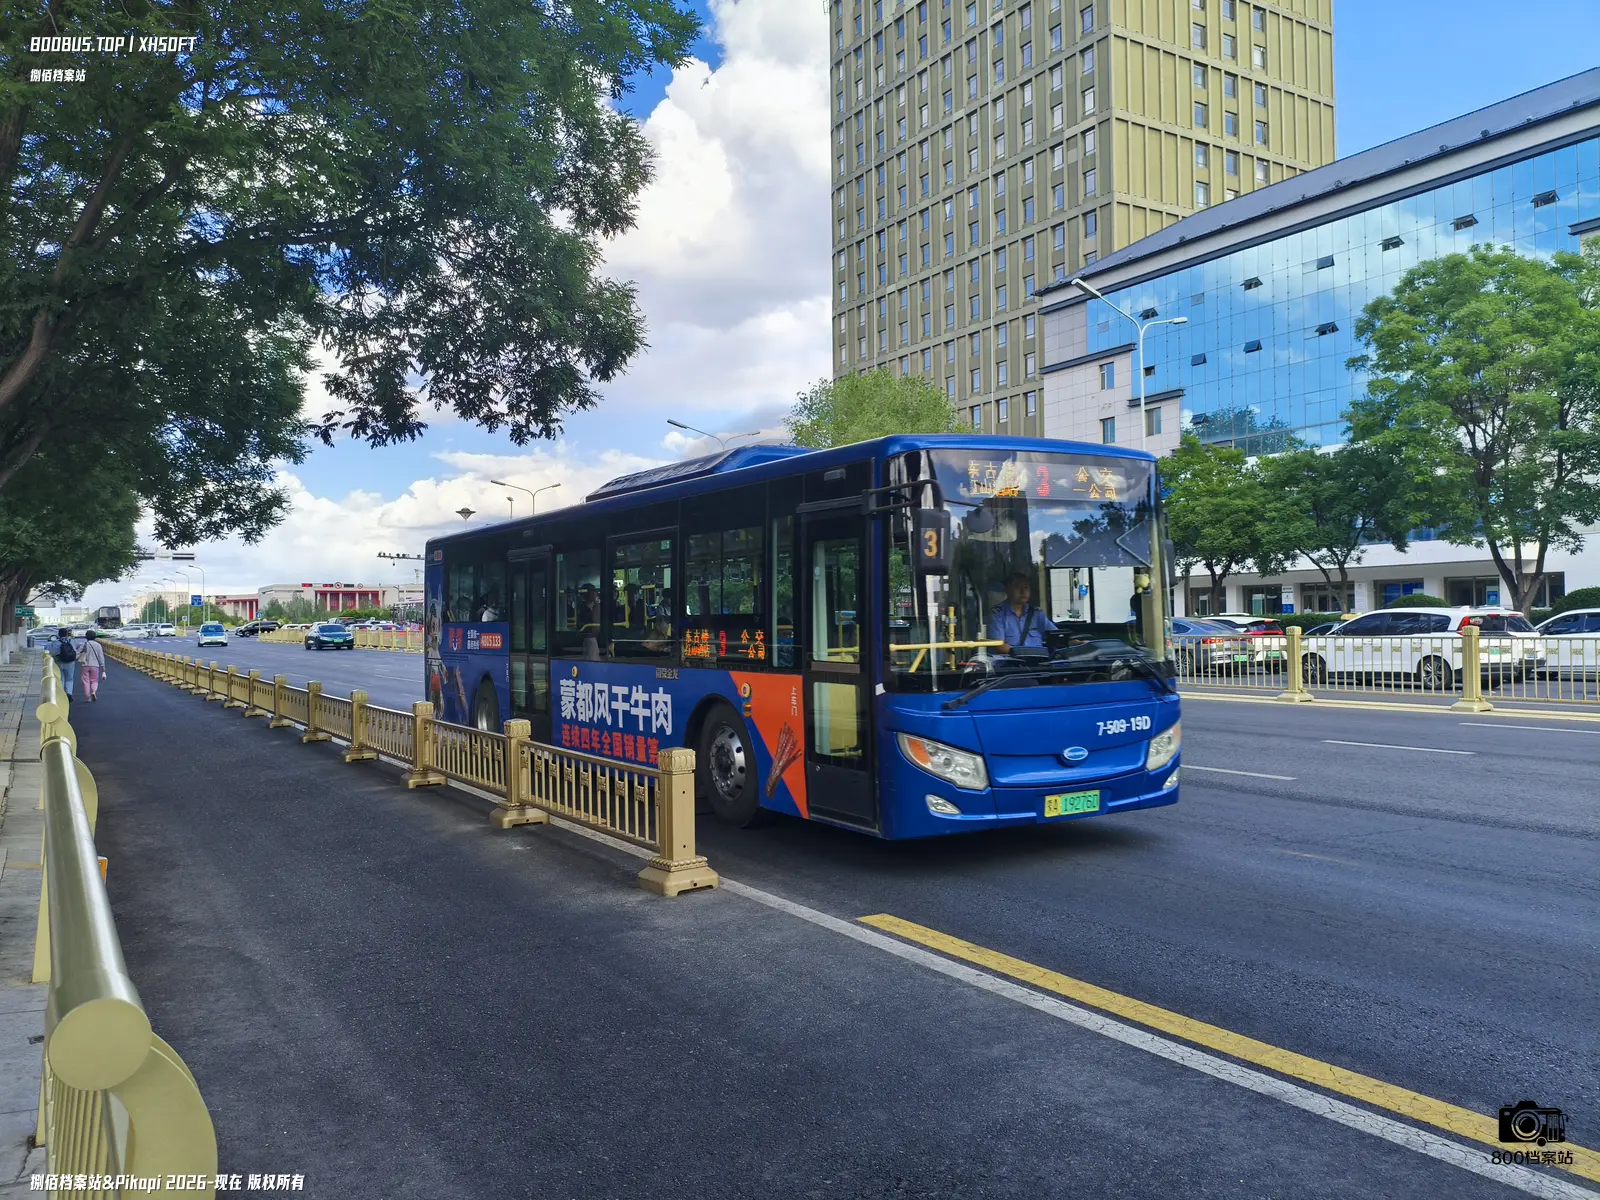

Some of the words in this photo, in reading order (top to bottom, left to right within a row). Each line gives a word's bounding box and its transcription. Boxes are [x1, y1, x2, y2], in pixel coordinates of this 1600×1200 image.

[923, 530, 938, 557] 3
[559, 678, 673, 736] 蒙都风干牛肉
